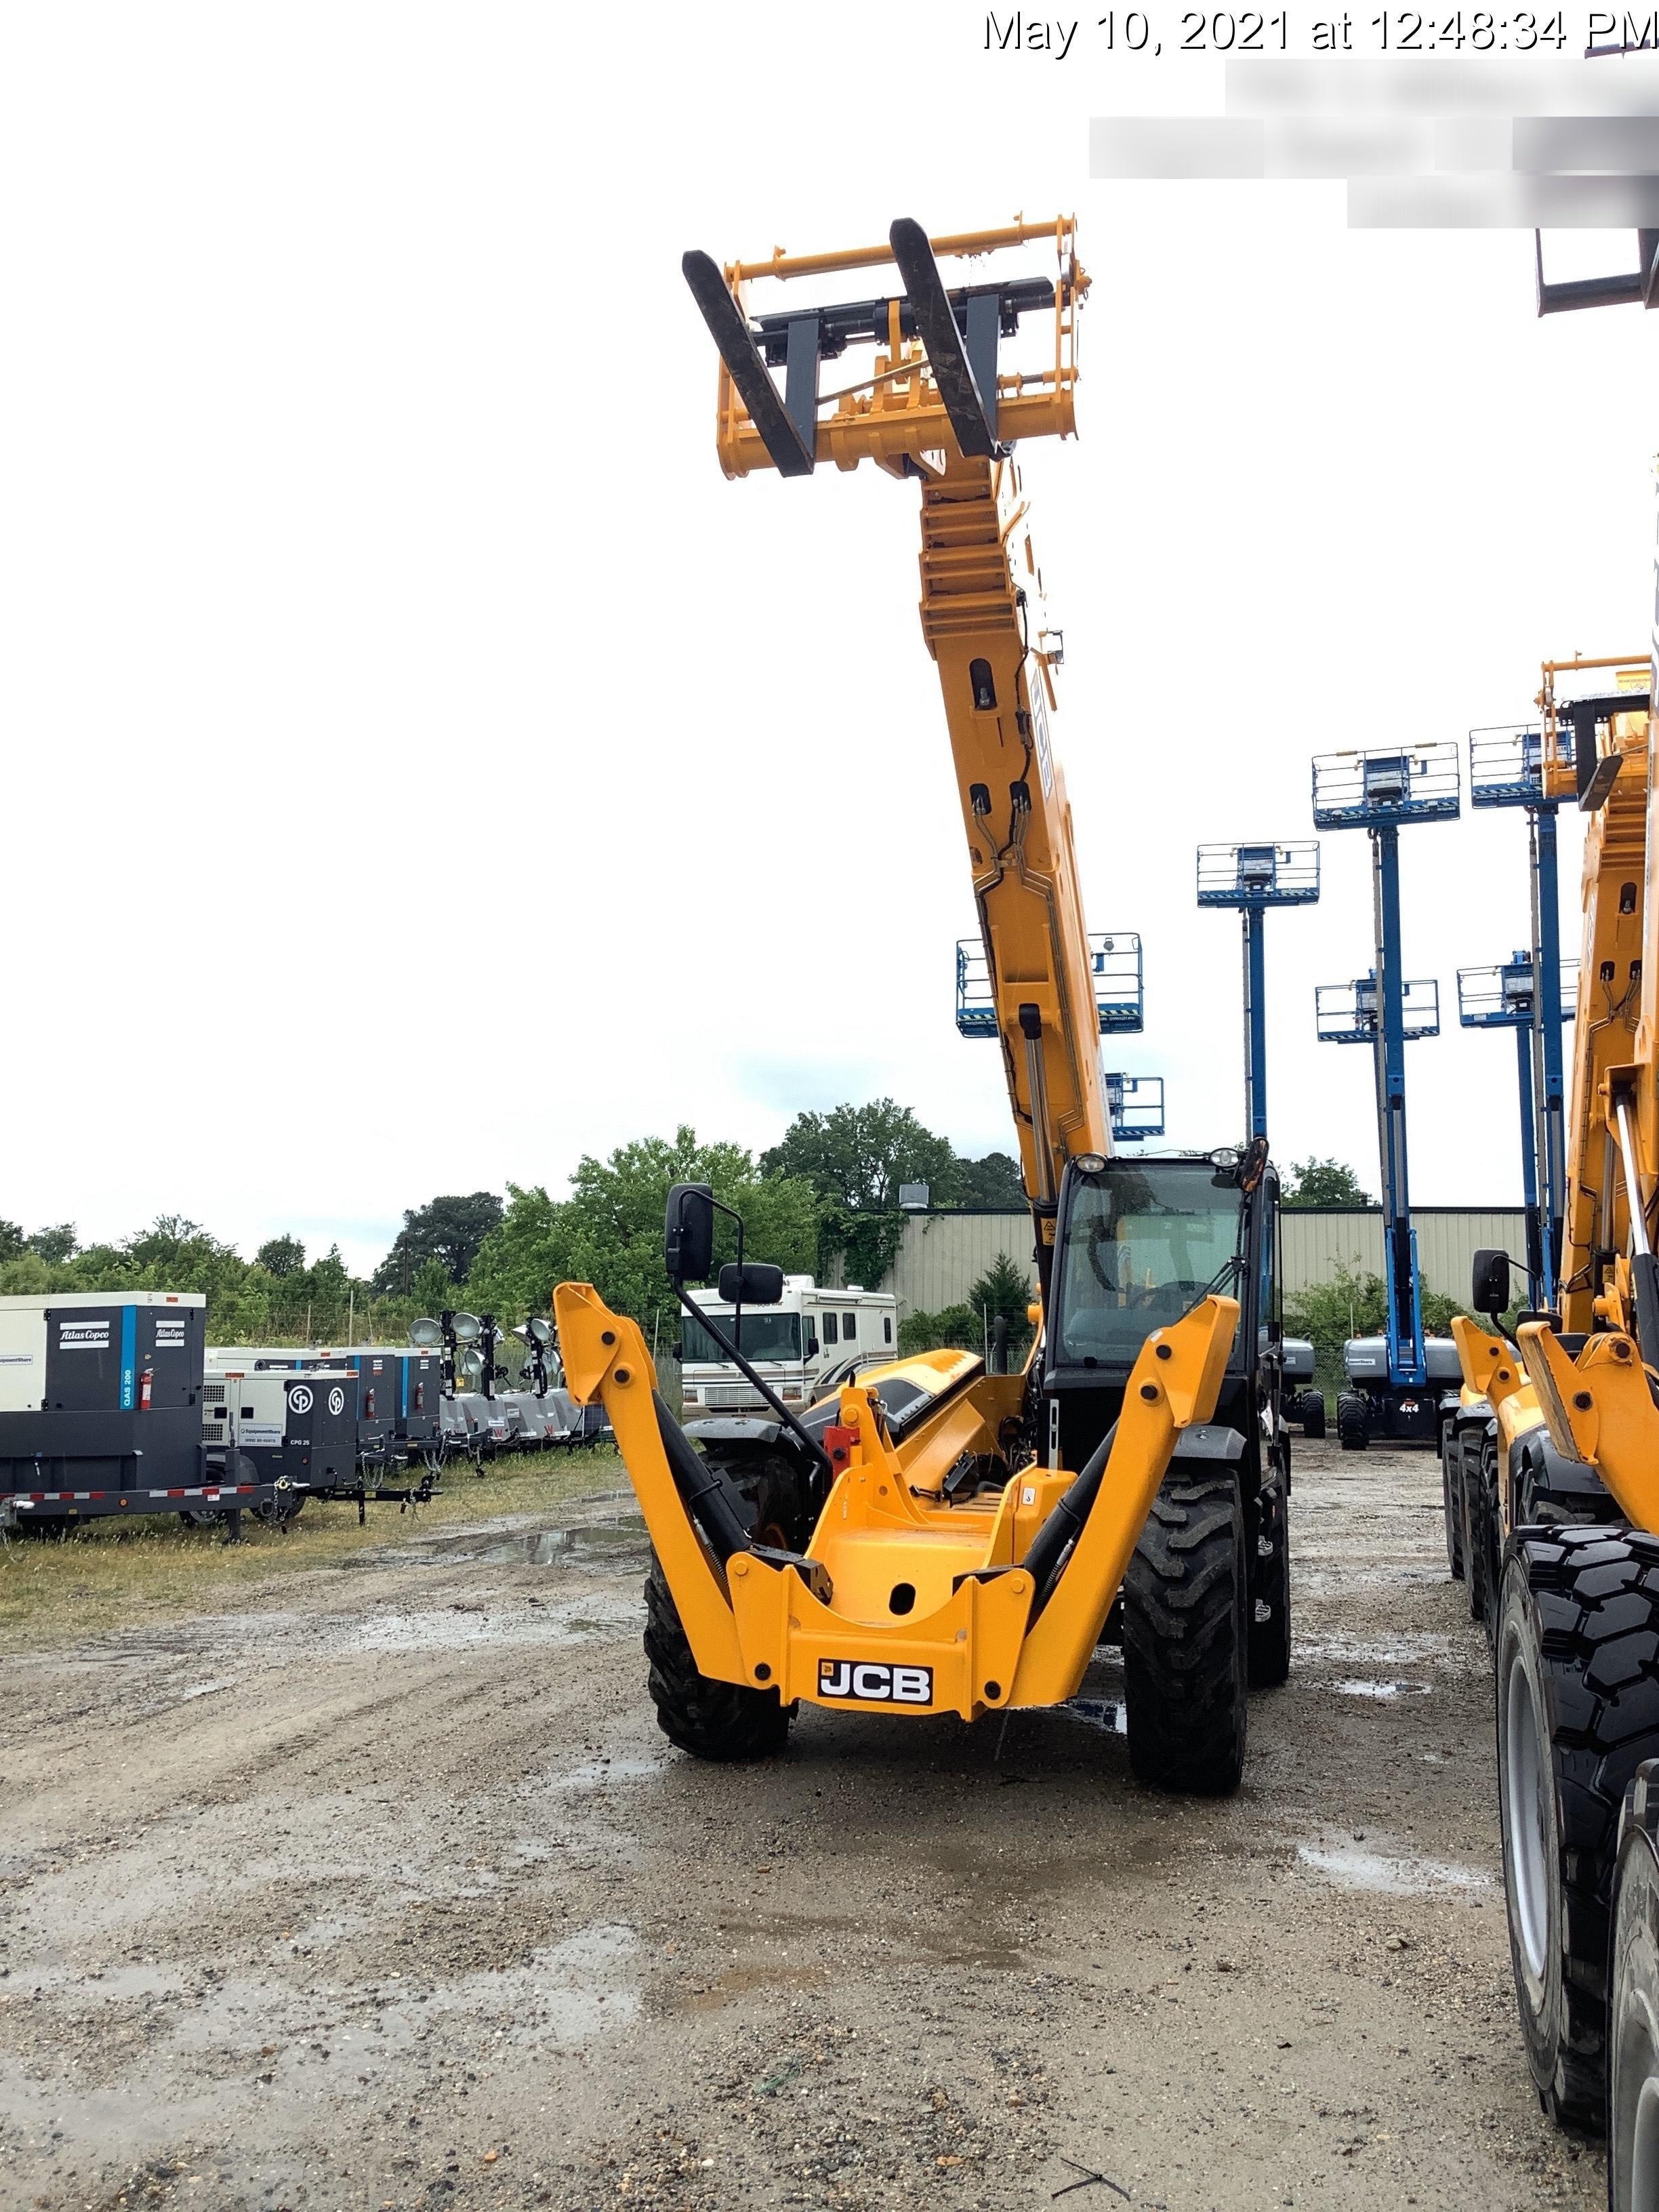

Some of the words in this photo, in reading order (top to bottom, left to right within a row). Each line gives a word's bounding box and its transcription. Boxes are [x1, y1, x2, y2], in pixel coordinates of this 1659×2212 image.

[60, 1330, 85, 1340] Atlas
[85, 1330, 109, 1340] Copco
[156, 1328, 170, 1338] Atlas
[170, 1329, 184, 1339] Copco
[1399, 1404, 1419, 1413] 4x4
[821, 1663, 930, 1702] JCB
